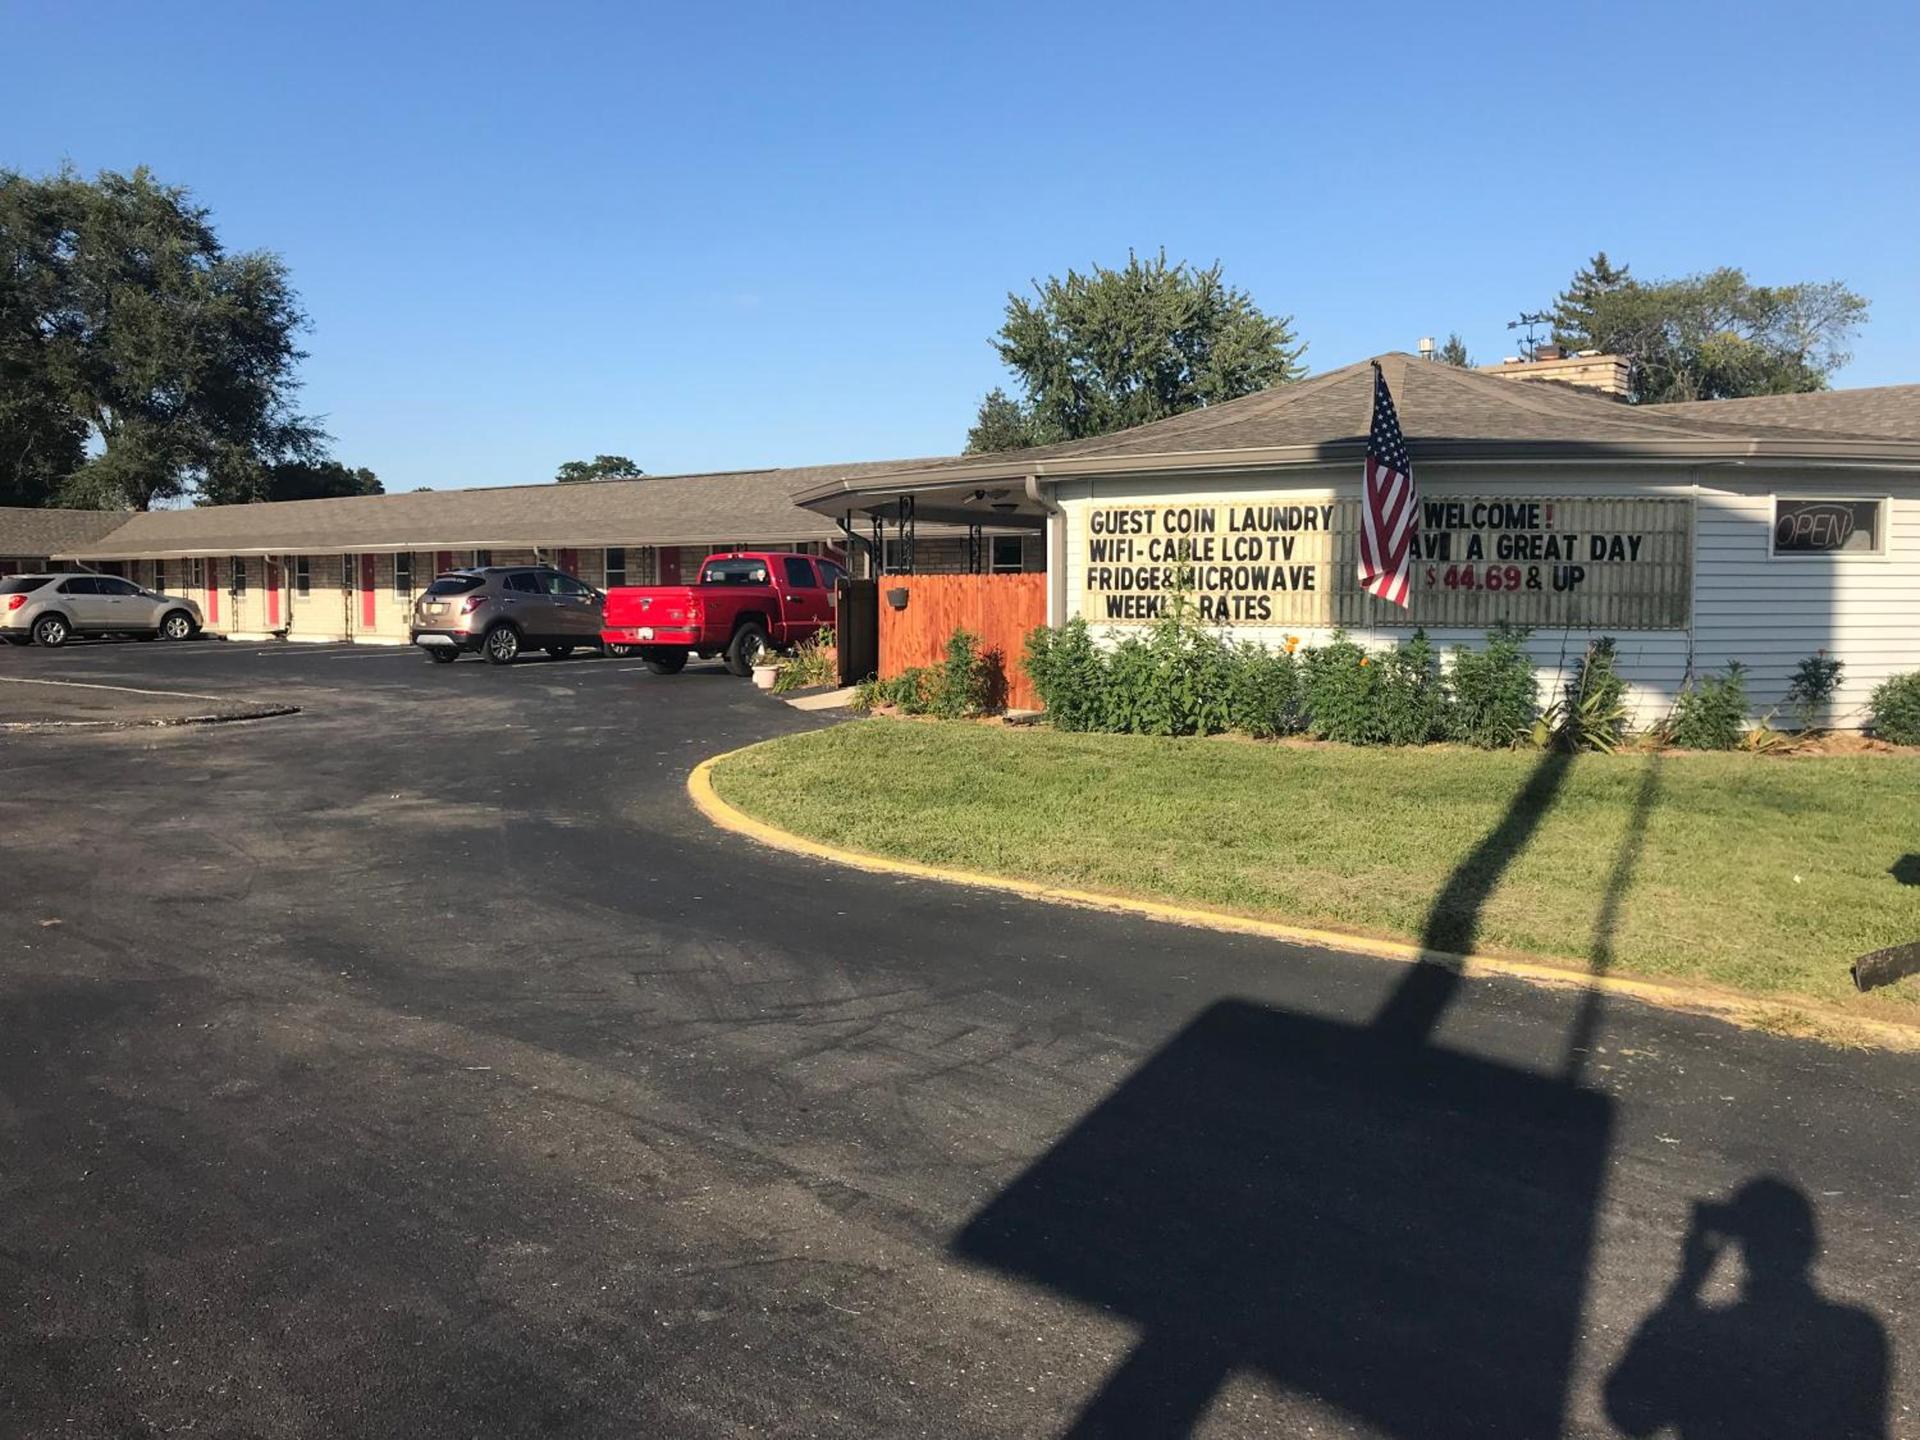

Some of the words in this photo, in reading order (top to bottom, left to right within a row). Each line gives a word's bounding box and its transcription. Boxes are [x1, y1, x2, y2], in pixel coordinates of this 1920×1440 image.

[1090, 510, 1156, 535] GUEST
[1163, 508, 1216, 533] COIN
[1229, 505, 1334, 532] LAUNDRY
[1775, 513, 1849, 546] OPEN
[1466, 534, 1484, 560] A
[1497, 534, 1578, 561] GREAT
[1590, 534, 1642, 561] DAY
[1553, 565, 1585, 592] UP
[1200, 594, 1272, 621] RATES
